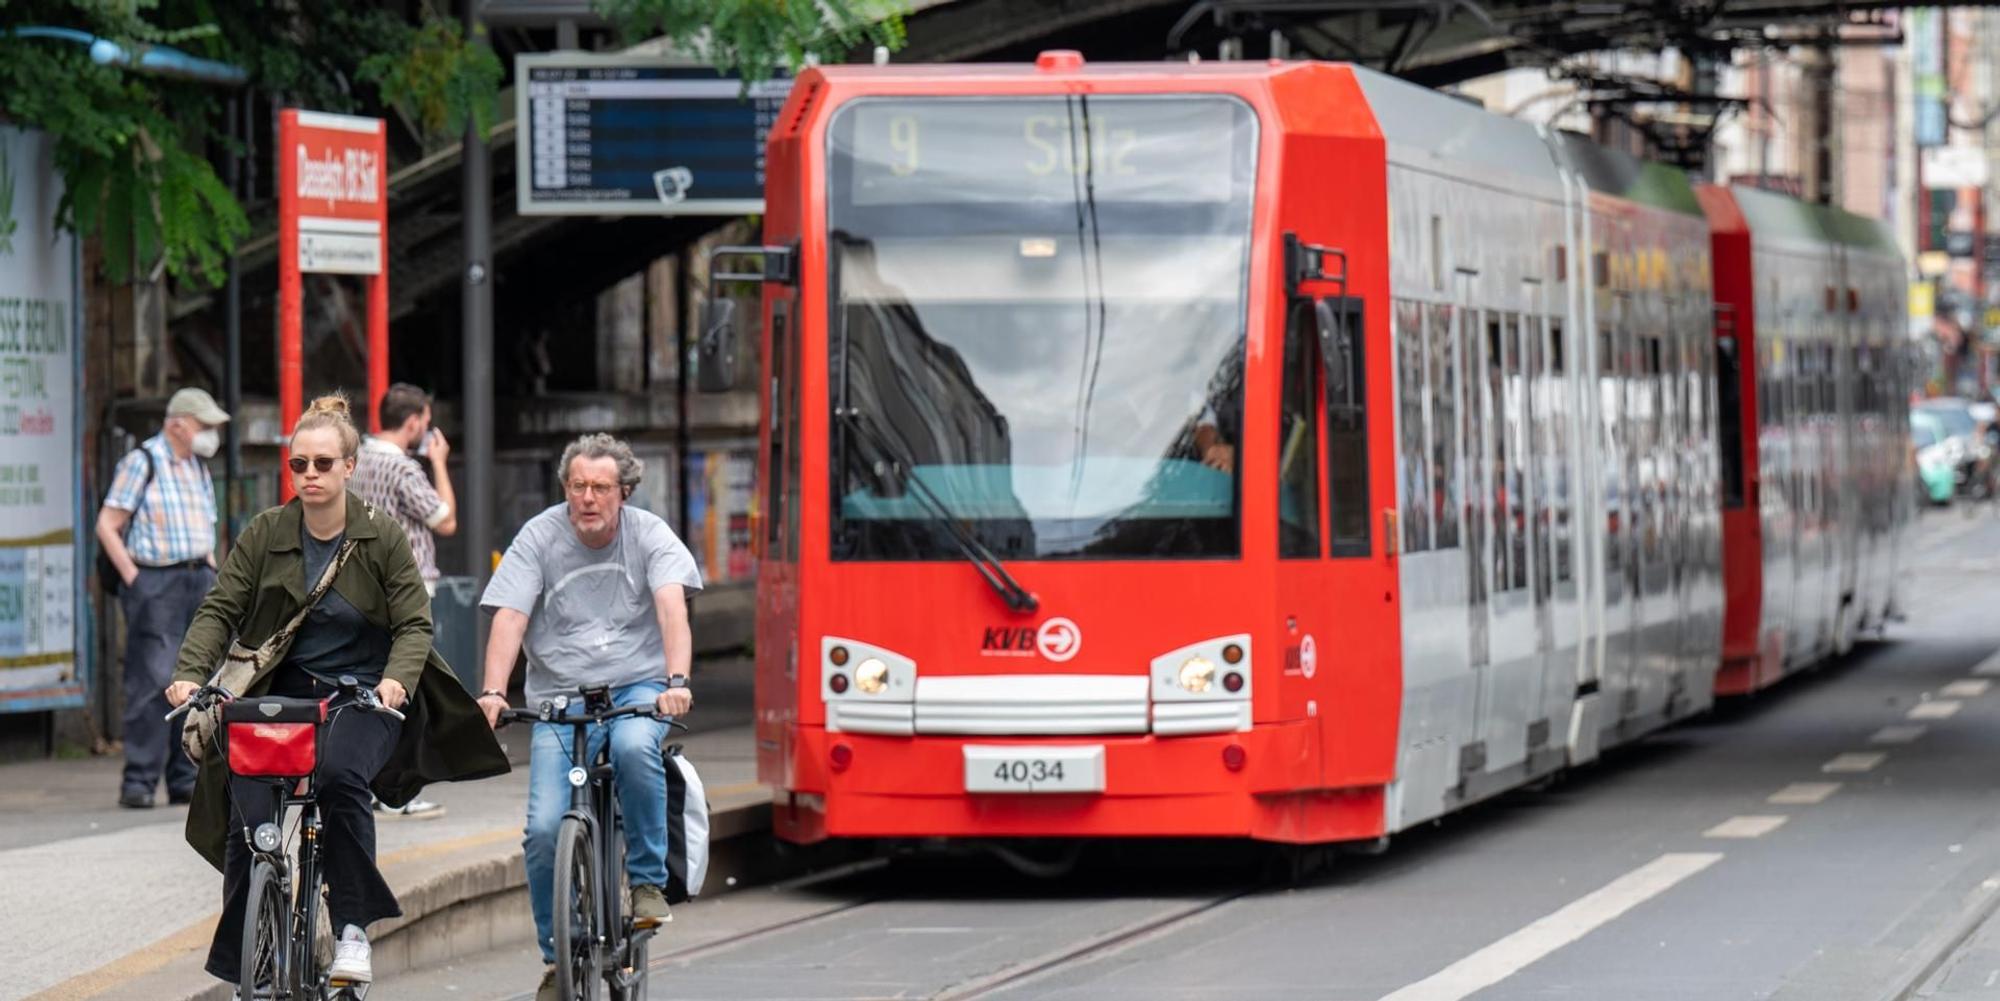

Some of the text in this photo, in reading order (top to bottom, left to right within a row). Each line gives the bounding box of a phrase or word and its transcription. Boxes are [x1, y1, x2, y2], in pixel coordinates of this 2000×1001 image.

[889, 116, 920, 176] 9
[981, 626, 1037, 651] KVB
[994, 760, 1064, 782] 4034
